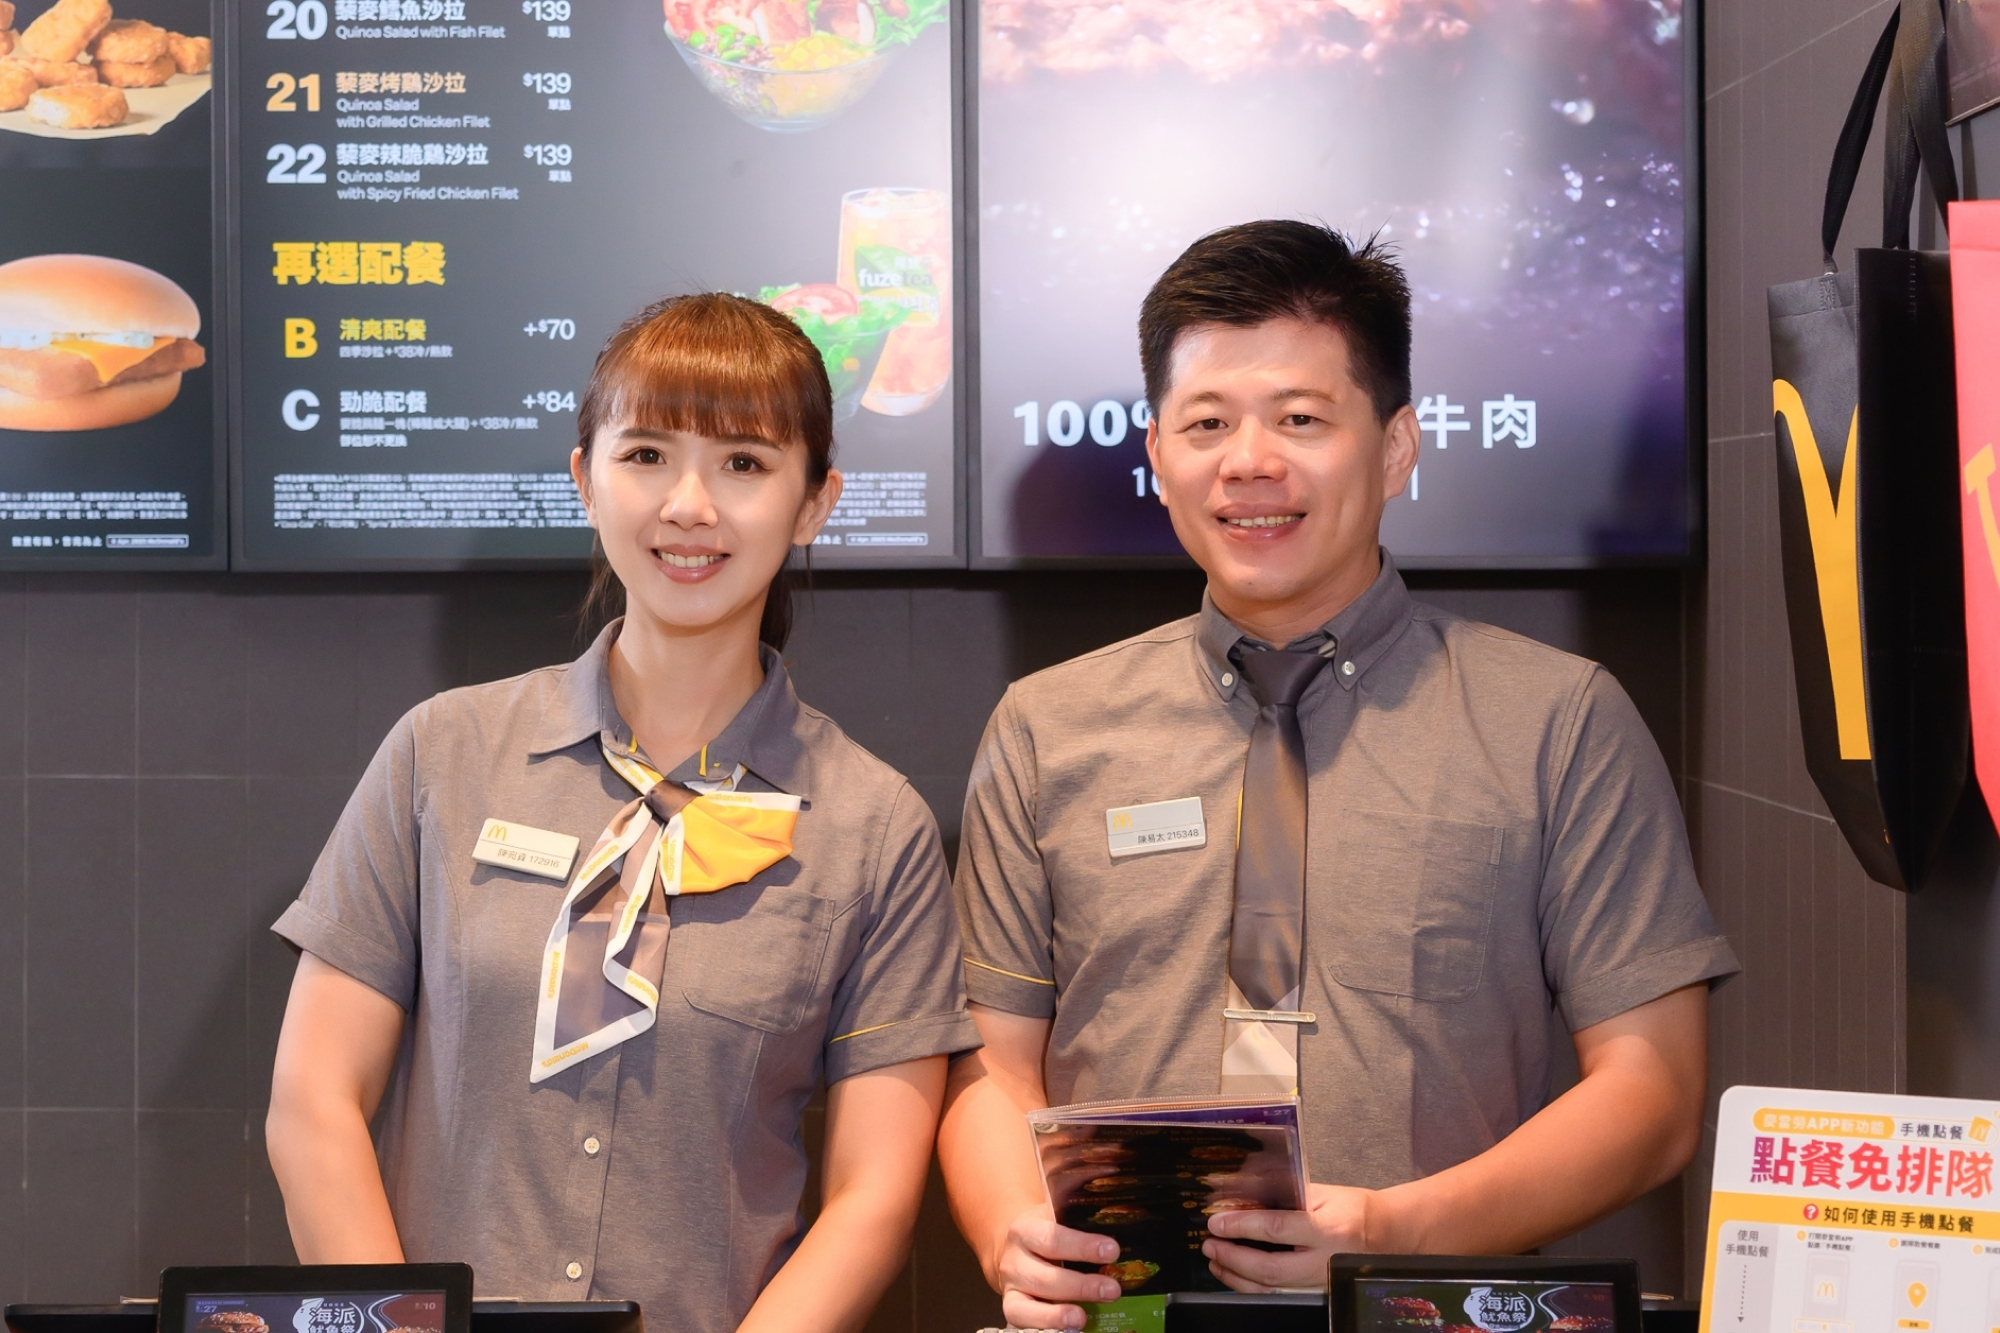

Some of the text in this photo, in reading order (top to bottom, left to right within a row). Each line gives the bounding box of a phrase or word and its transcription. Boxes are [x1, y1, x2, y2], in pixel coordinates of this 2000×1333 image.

[266, 0, 328, 40] 20
[522, 0, 571, 21] $139
[336, 25, 506, 40] Quinoa Salad with Fish Filet
[266, 73, 320, 111] 21
[523, 72, 571, 94] $139
[336, 98, 419, 112] Quinoa Salad
[337, 115, 491, 128] with Grilled Chicken Filet
[266, 144, 327, 184] 22
[523, 144, 572, 165] $139
[337, 170, 420, 184] Quinoa Salad
[337, 187, 519, 202] with Spicy Fried Chicken Filet
[273, 241, 446, 285] 再選配餐
[284, 318, 318, 358] B
[340, 318, 427, 341] 清爽配餐
[523, 318, 576, 341] +$70
[282, 389, 320, 431] C
[340, 390, 427, 413] 勁脆配餐
[522, 390, 577, 413] +$84
[1167, 829, 1199, 841] 215348
[530, 855, 560, 868] 172916
[547, 951, 561, 999] McDonald's
[541, 1042, 589, 1069] McDonald's
[1900, 1123, 1963, 1141] 手機點餐
[1750, 1136, 1995, 1200] 點餐免排隊
[1824, 1206, 1975, 1234] 如何使用手機點餐
[1737, 1229, 1759, 1242] 使用
[1726, 1243, 1769, 1258] 手機點餐
[1480, 1295, 1527, 1312] 海派
[309, 1307, 356, 1325] 海派
[1481, 1312, 1527, 1323] 魷魚祭
